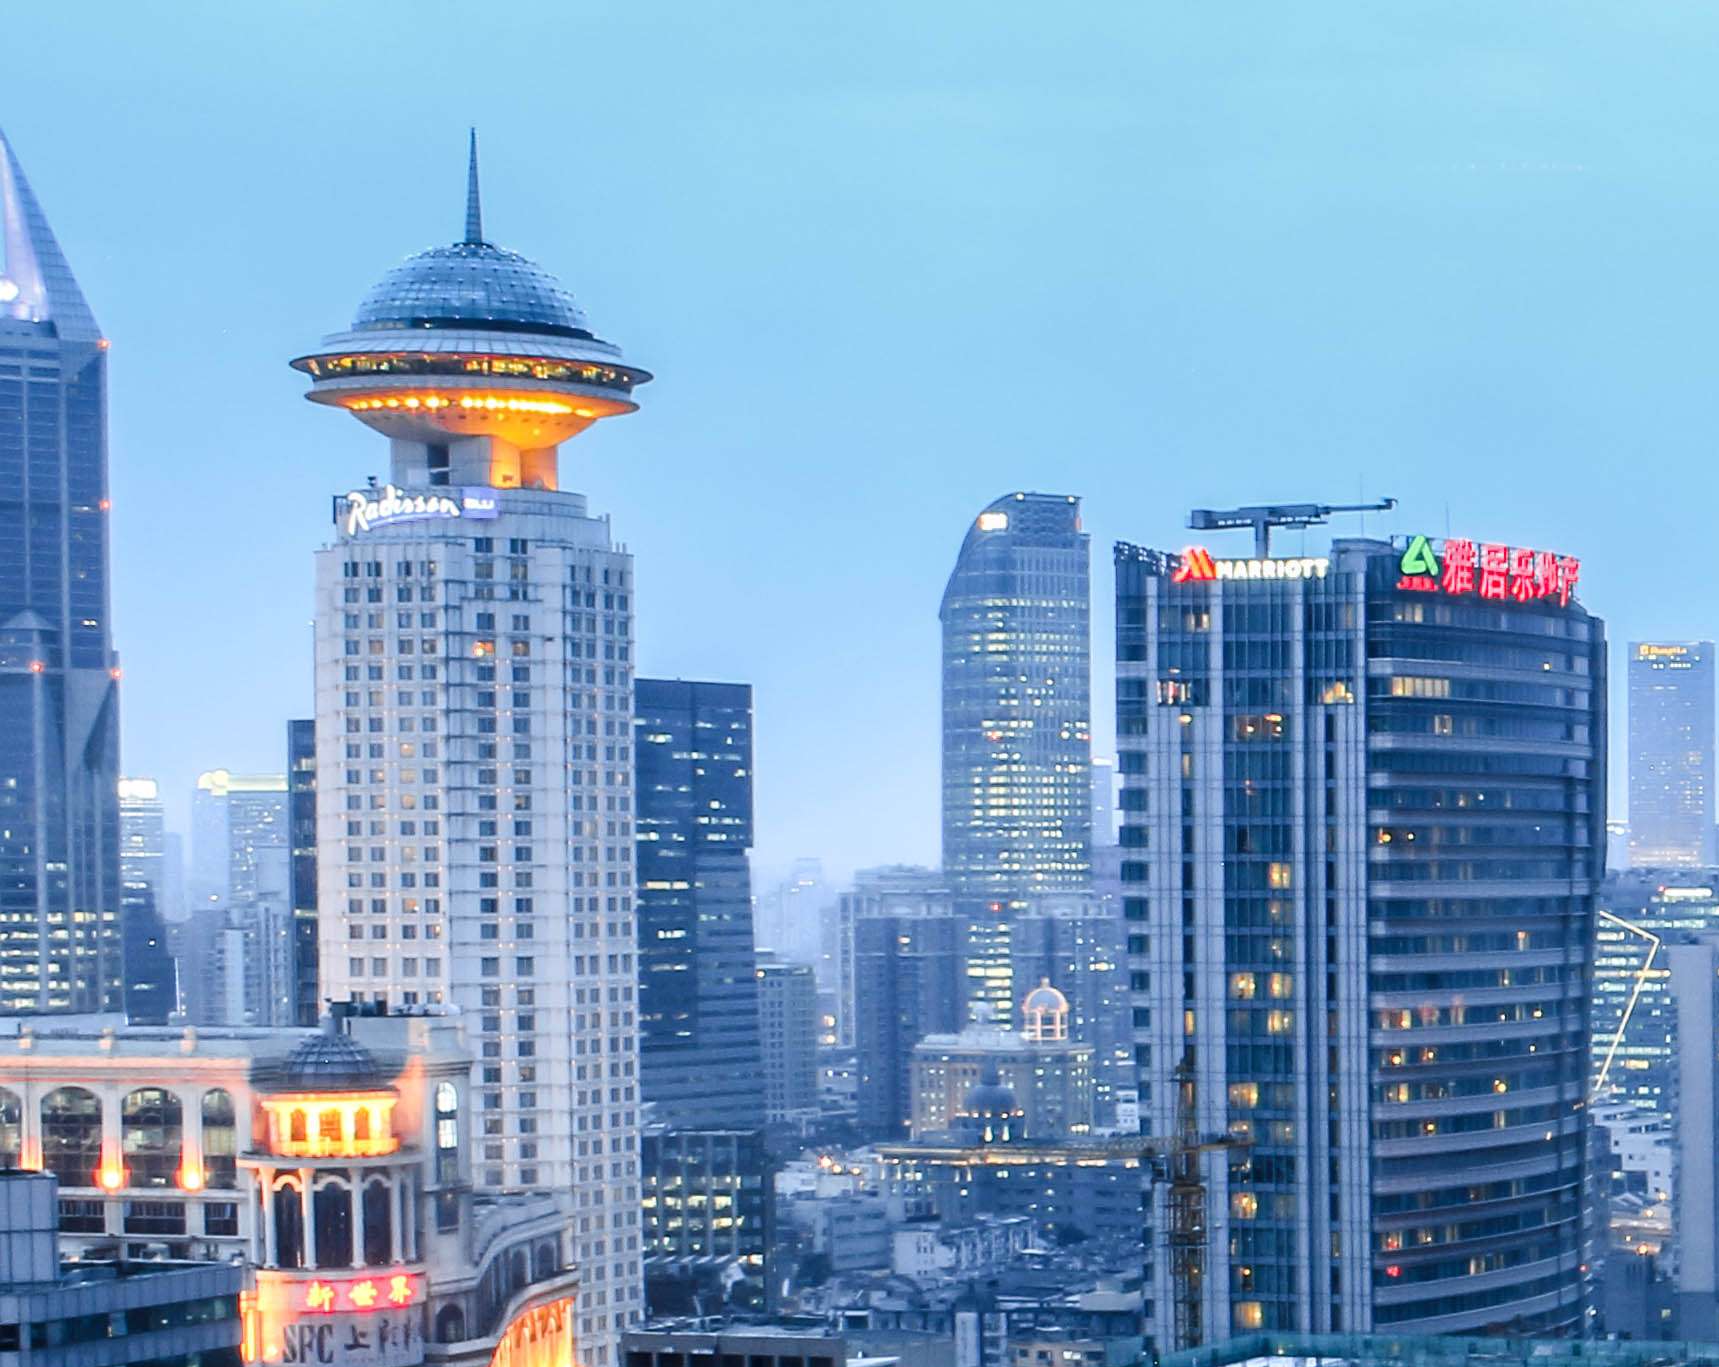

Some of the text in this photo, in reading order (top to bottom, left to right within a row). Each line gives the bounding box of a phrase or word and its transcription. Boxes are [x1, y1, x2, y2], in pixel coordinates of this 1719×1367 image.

[347, 484, 460, 536] Radisson
[1215, 557, 1329, 580] MARRIOTT
[1442, 538, 1582, 608] 雅居乐地产
[306, 1275, 411, 1312] 新世界
[282, 1323, 334, 1364] SPC
